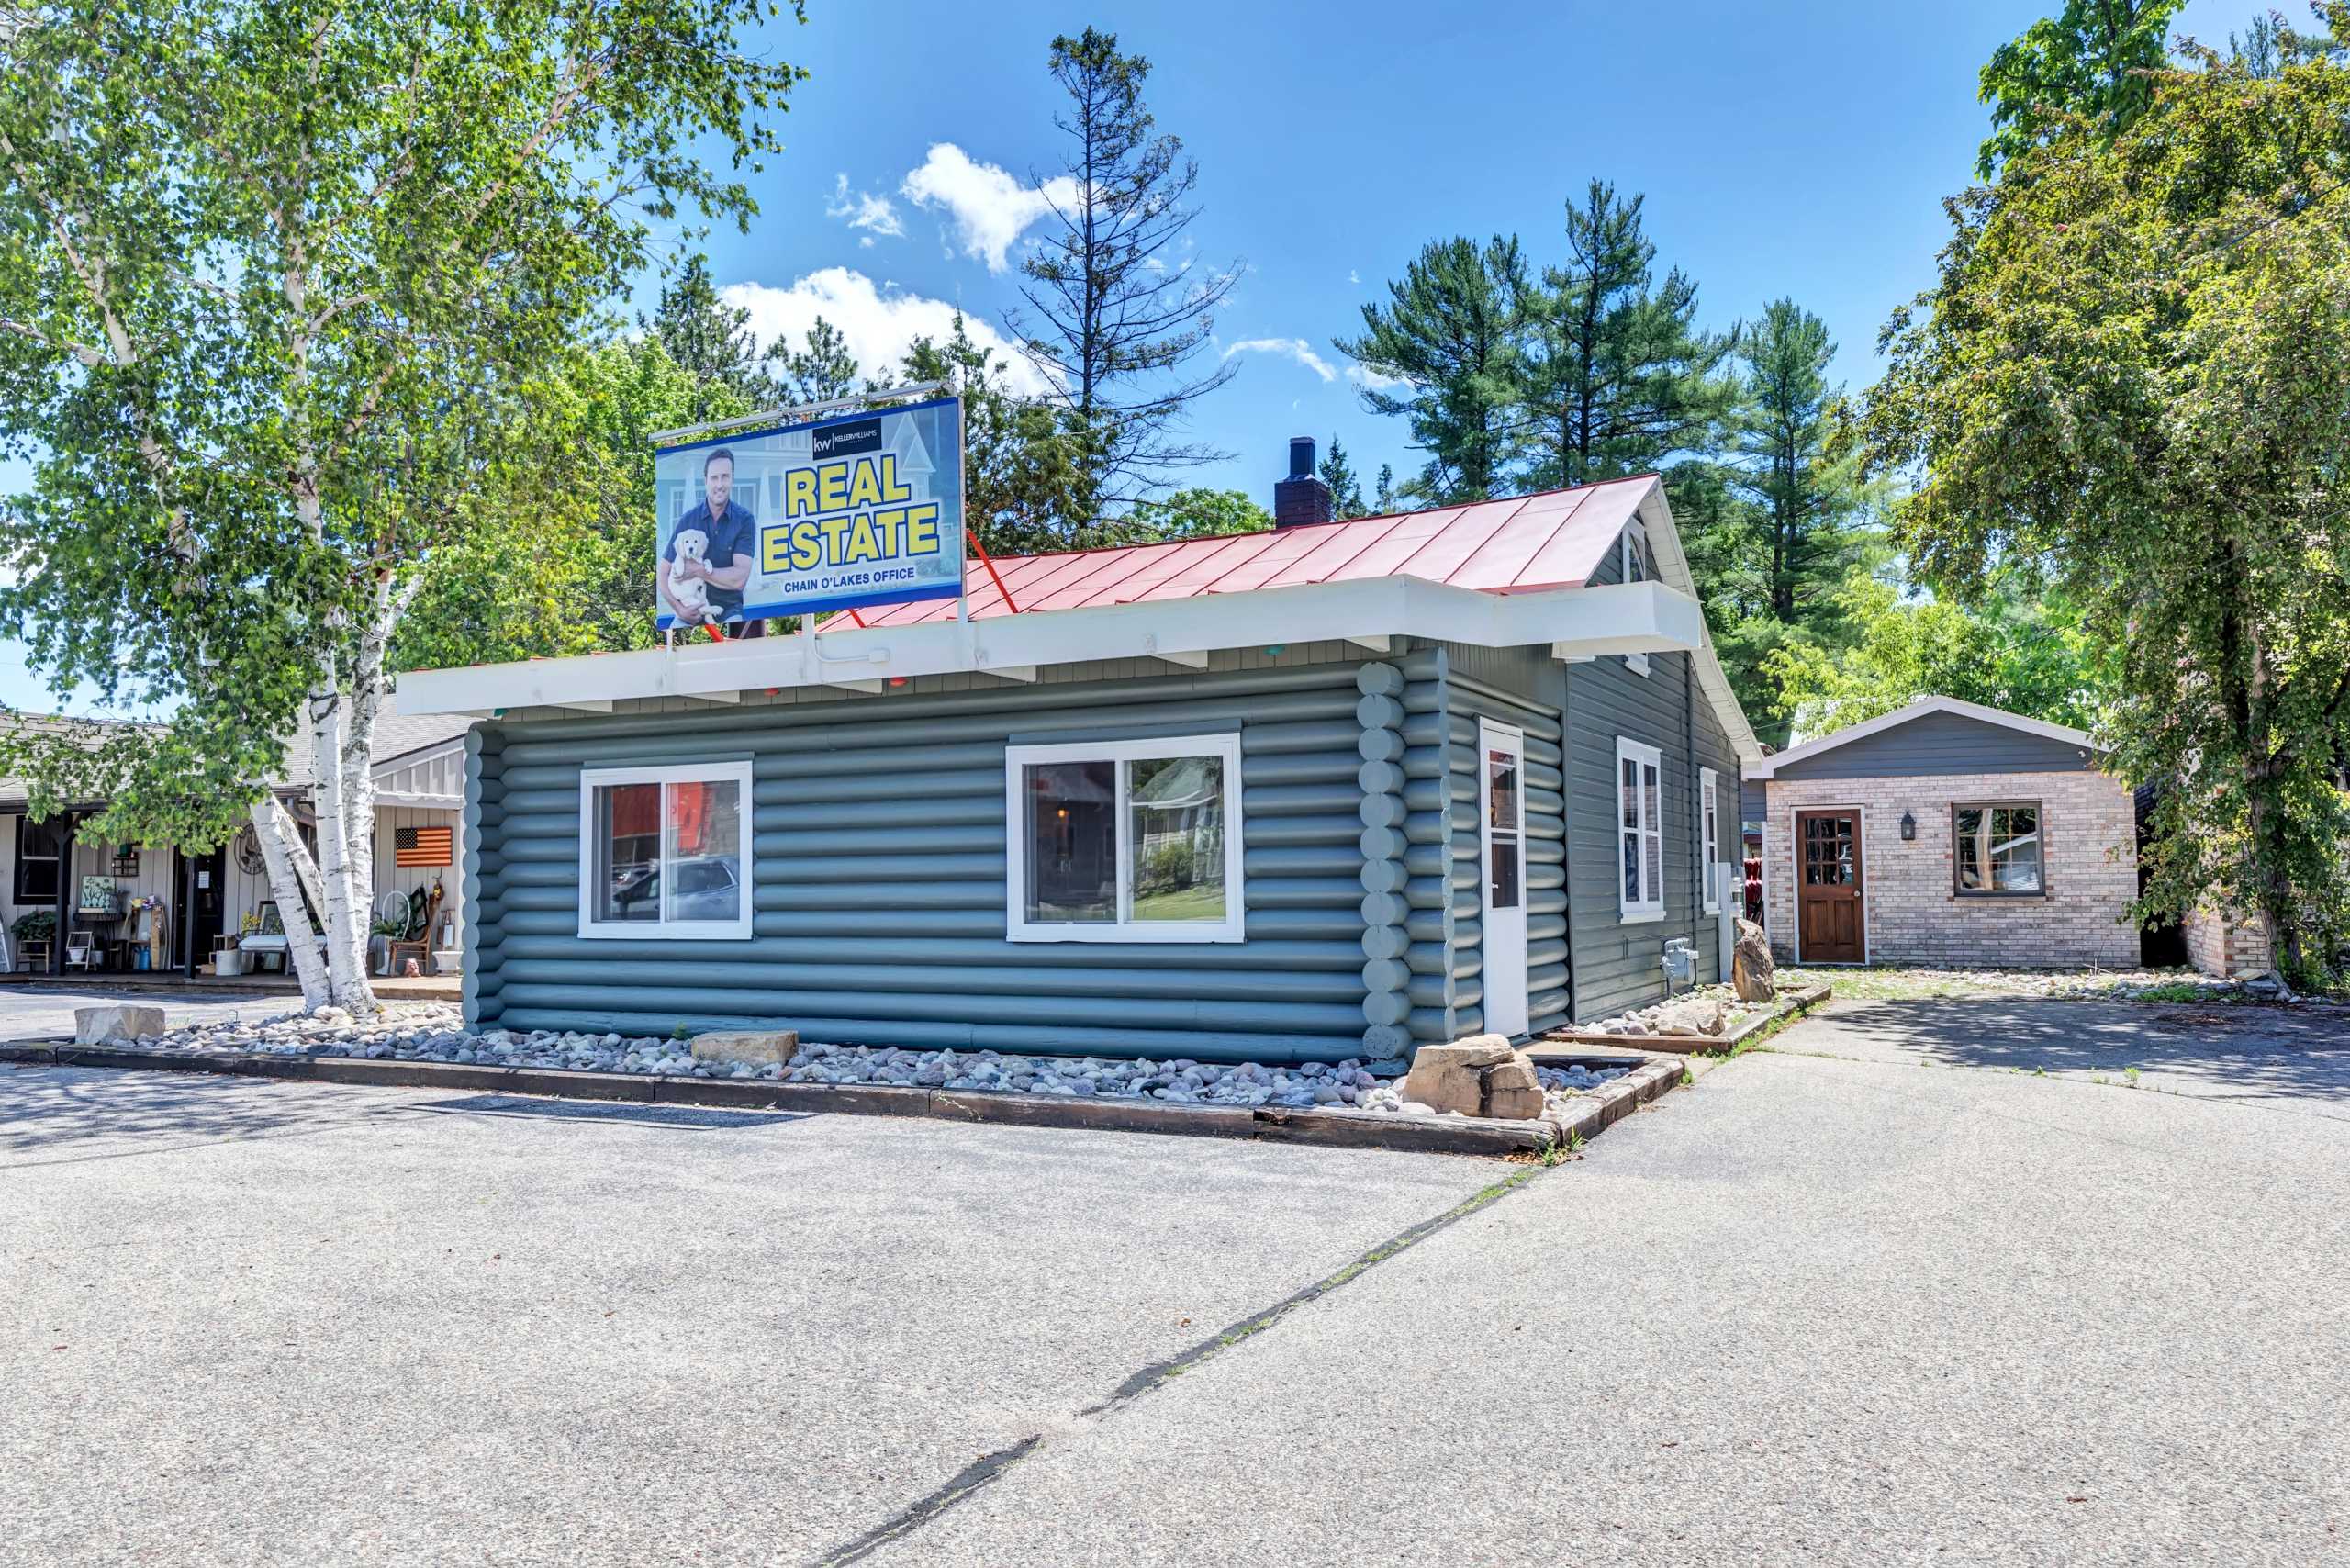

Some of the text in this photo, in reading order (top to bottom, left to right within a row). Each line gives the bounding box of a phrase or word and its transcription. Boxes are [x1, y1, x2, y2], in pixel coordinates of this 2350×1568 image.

[814, 437, 832, 452] kw
[786, 453, 911, 519] REAL
[761, 502, 940, 575] ESTATE
[784, 567, 914, 593] CHAIN O'LAKES OFFICE
